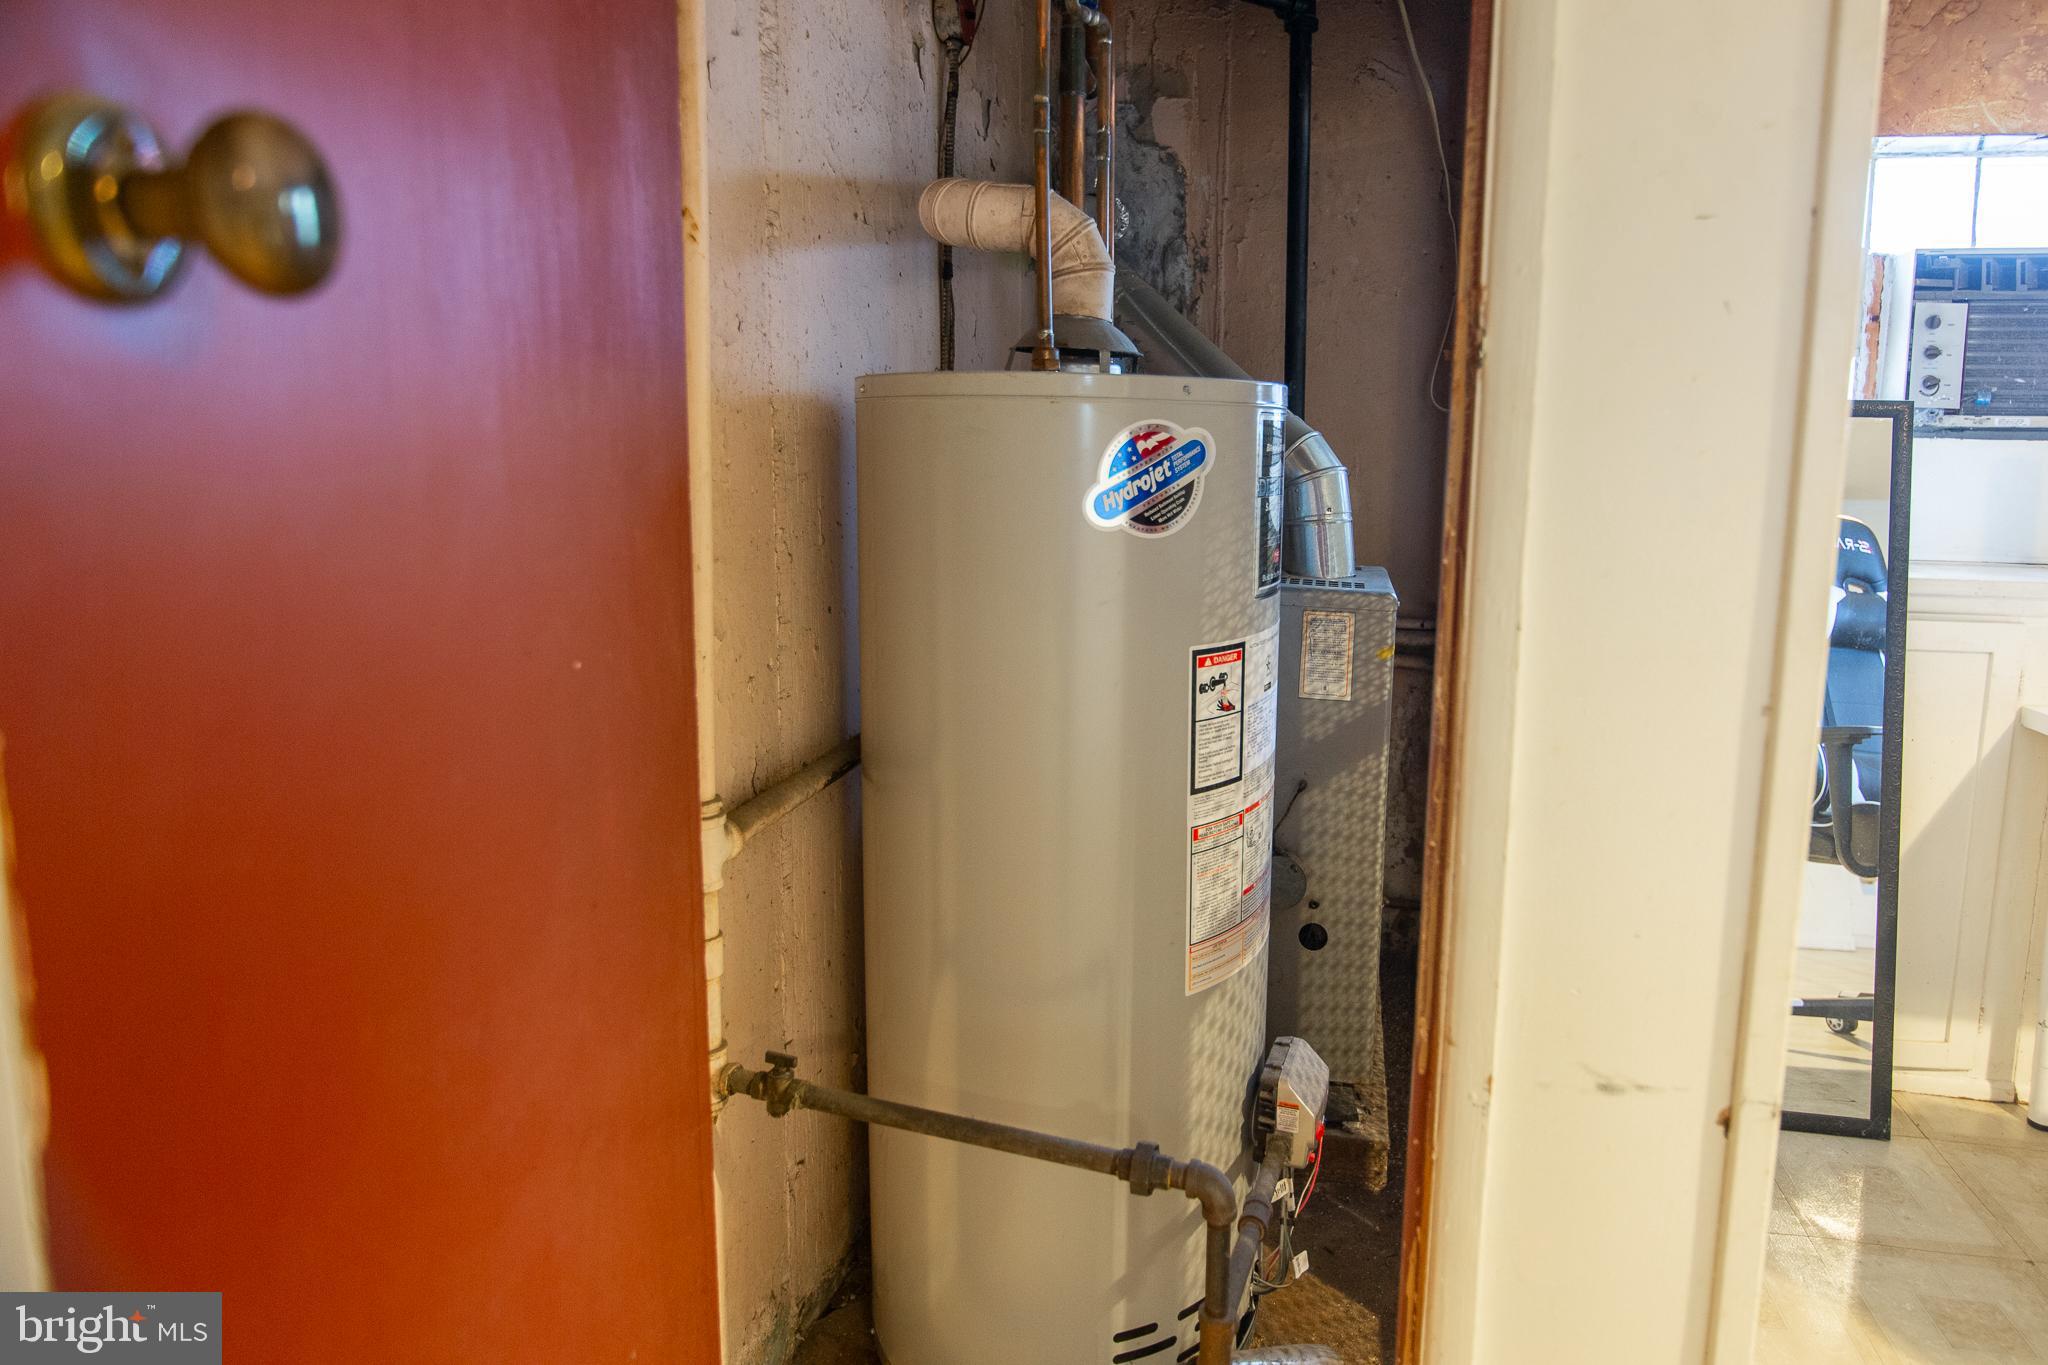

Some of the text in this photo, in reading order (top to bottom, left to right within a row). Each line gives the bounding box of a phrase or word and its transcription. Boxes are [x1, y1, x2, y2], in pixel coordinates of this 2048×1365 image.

[1173, 445, 1201, 468] PERFORMANCE
[1174, 461, 1191, 474] SYSTEM
[1103, 460, 1172, 512] Hydrojet
[1213, 653, 1237, 664] DANGER
